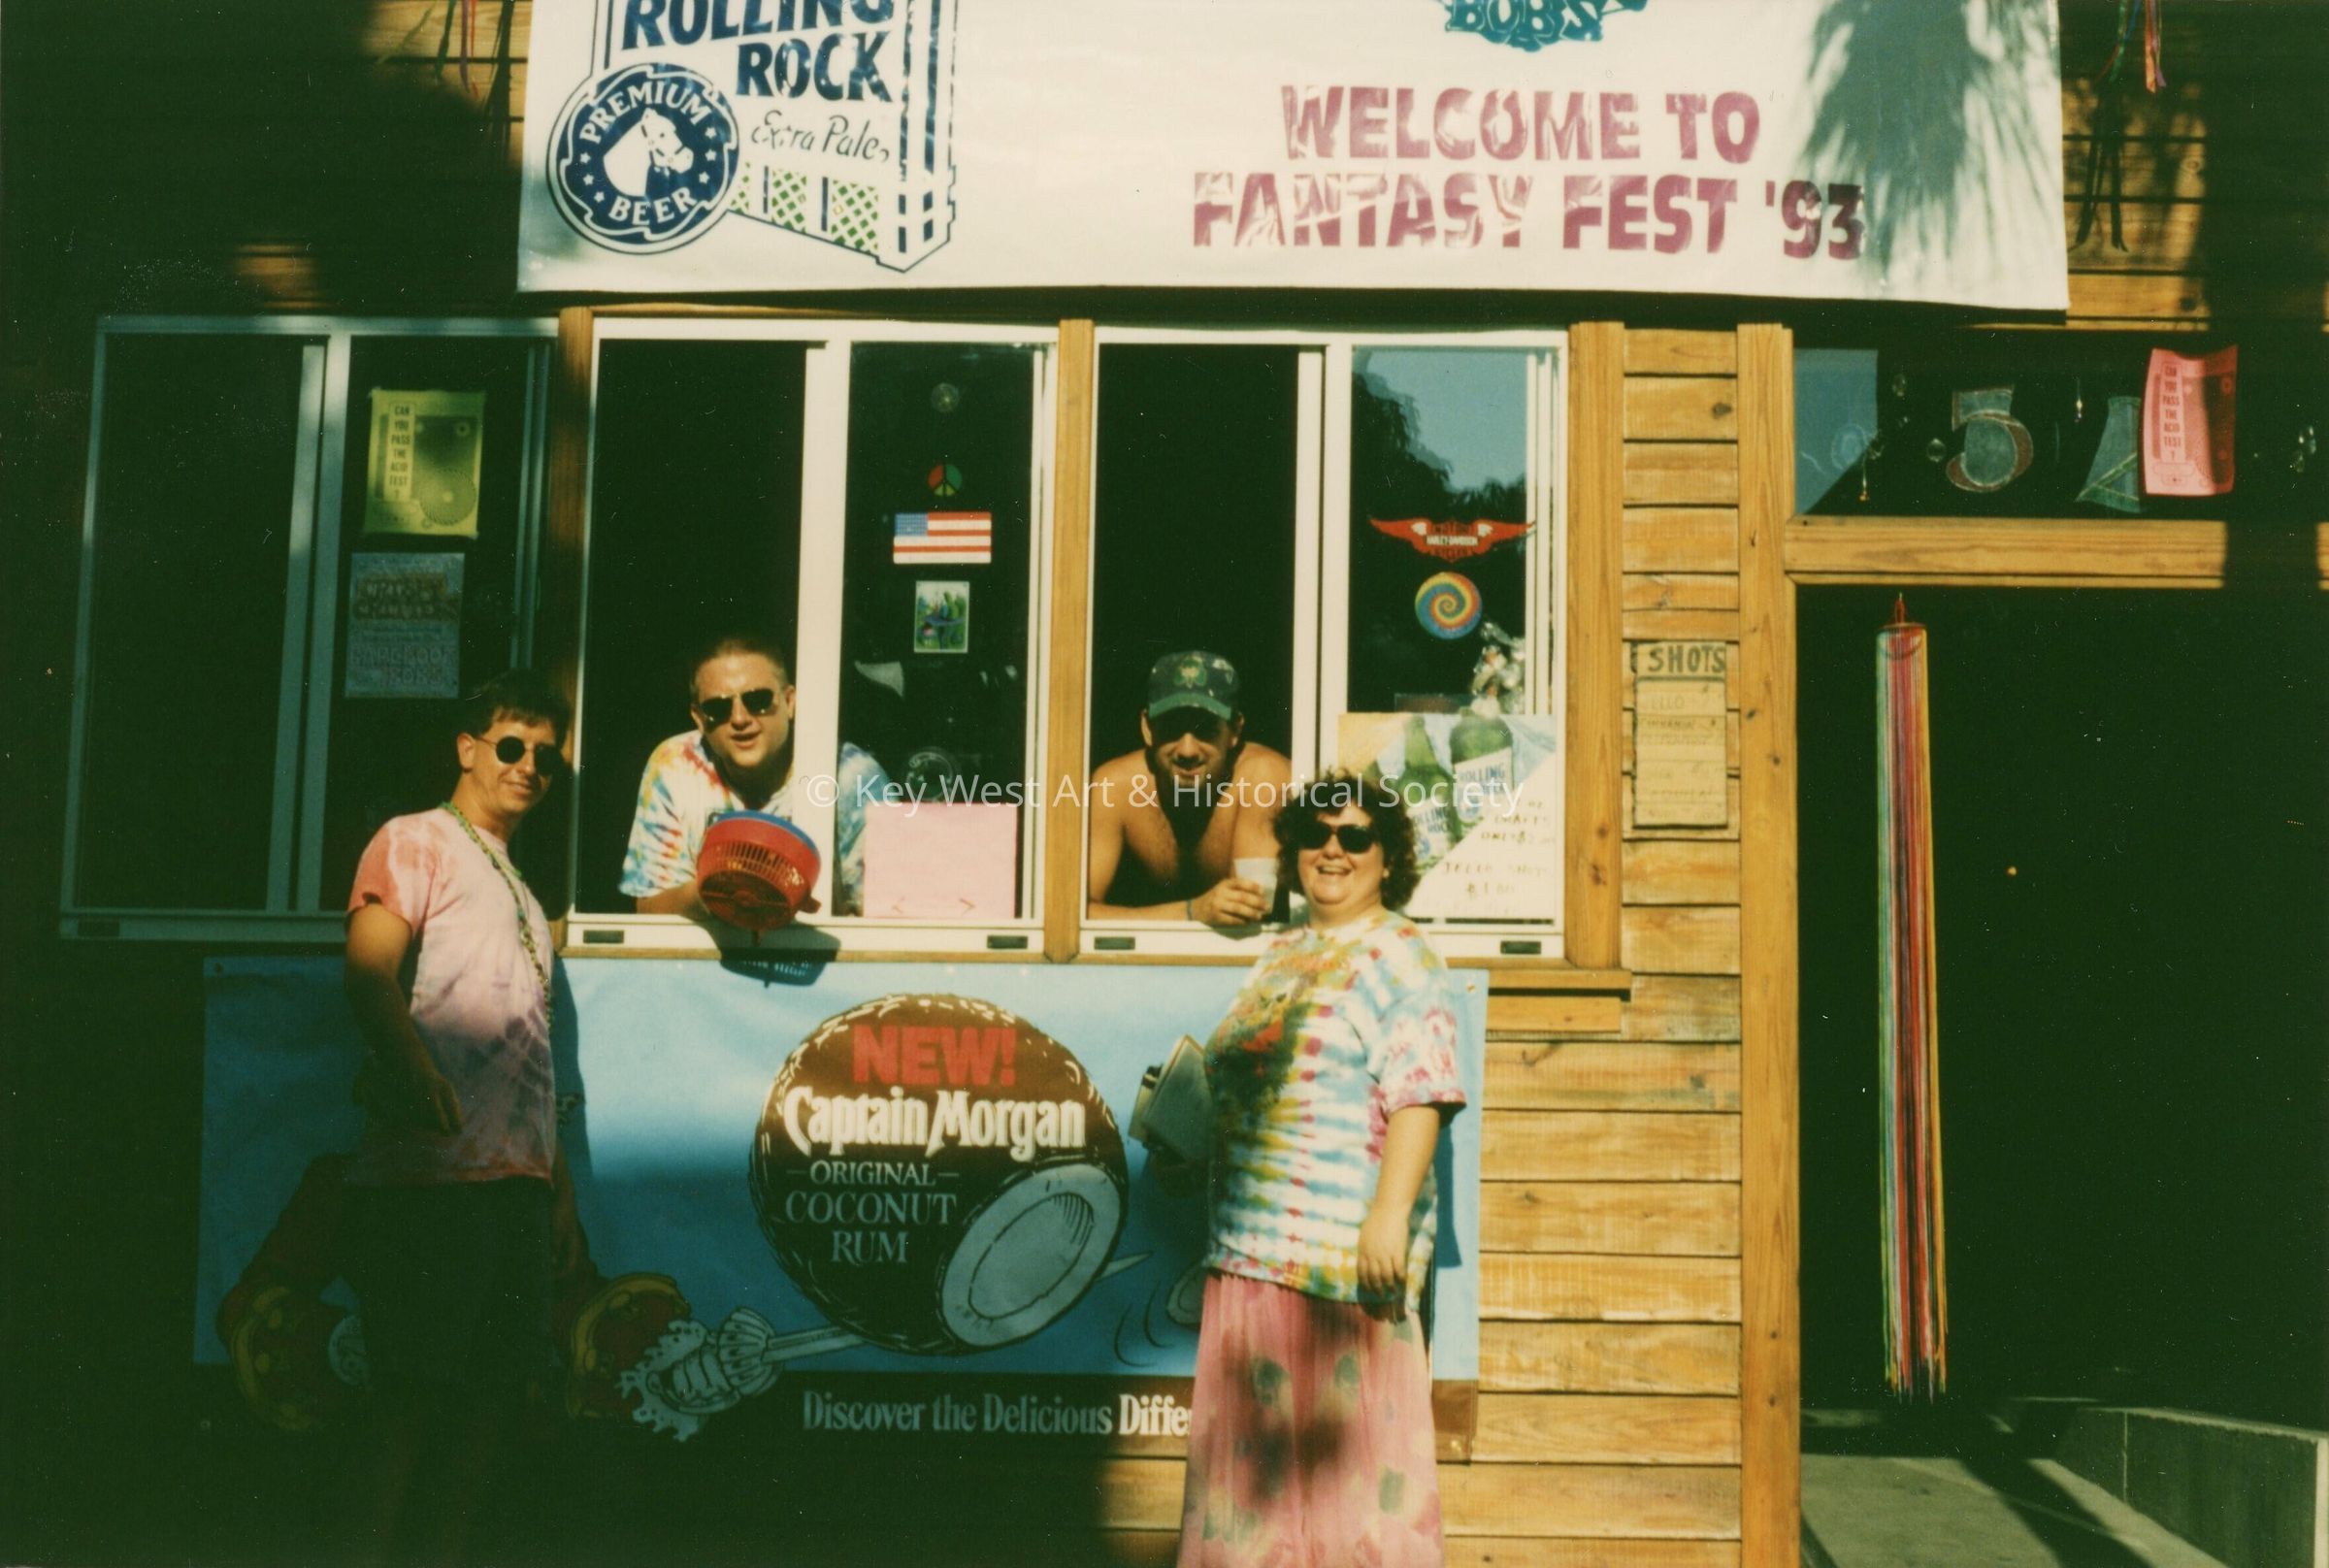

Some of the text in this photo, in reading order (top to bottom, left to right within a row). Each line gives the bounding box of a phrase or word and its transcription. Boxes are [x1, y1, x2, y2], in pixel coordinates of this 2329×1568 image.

[736, 30, 893, 102] ROCK
[579, 81, 712, 144] PREMIUM
[751, 110, 816, 150] Extra
[1280, 85, 1760, 164] WELCOME TO
[608, 187, 697, 226] BEER
[1194, 172, 1865, 260] FANTASY FEST '93
[2162, 395, 2180, 406] PASS
[2165, 409, 2177, 420] THE
[391, 434, 410, 445] PASS
[2163, 437, 2181, 447] TEST
[389, 475, 408, 486] TEST
[1648, 644, 1726, 673] SHOTS
[852, 1025, 1017, 1087] NEW!
[782, 1085, 1086, 1162] Captain Morgan
[809, 1160, 935, 1189] ORIGINAL
[785, 1191, 957, 1225] COCONUT
[832, 1230, 908, 1263] RUM
[803, 1390, 1193, 1437] Discover the Delicious Diffe
